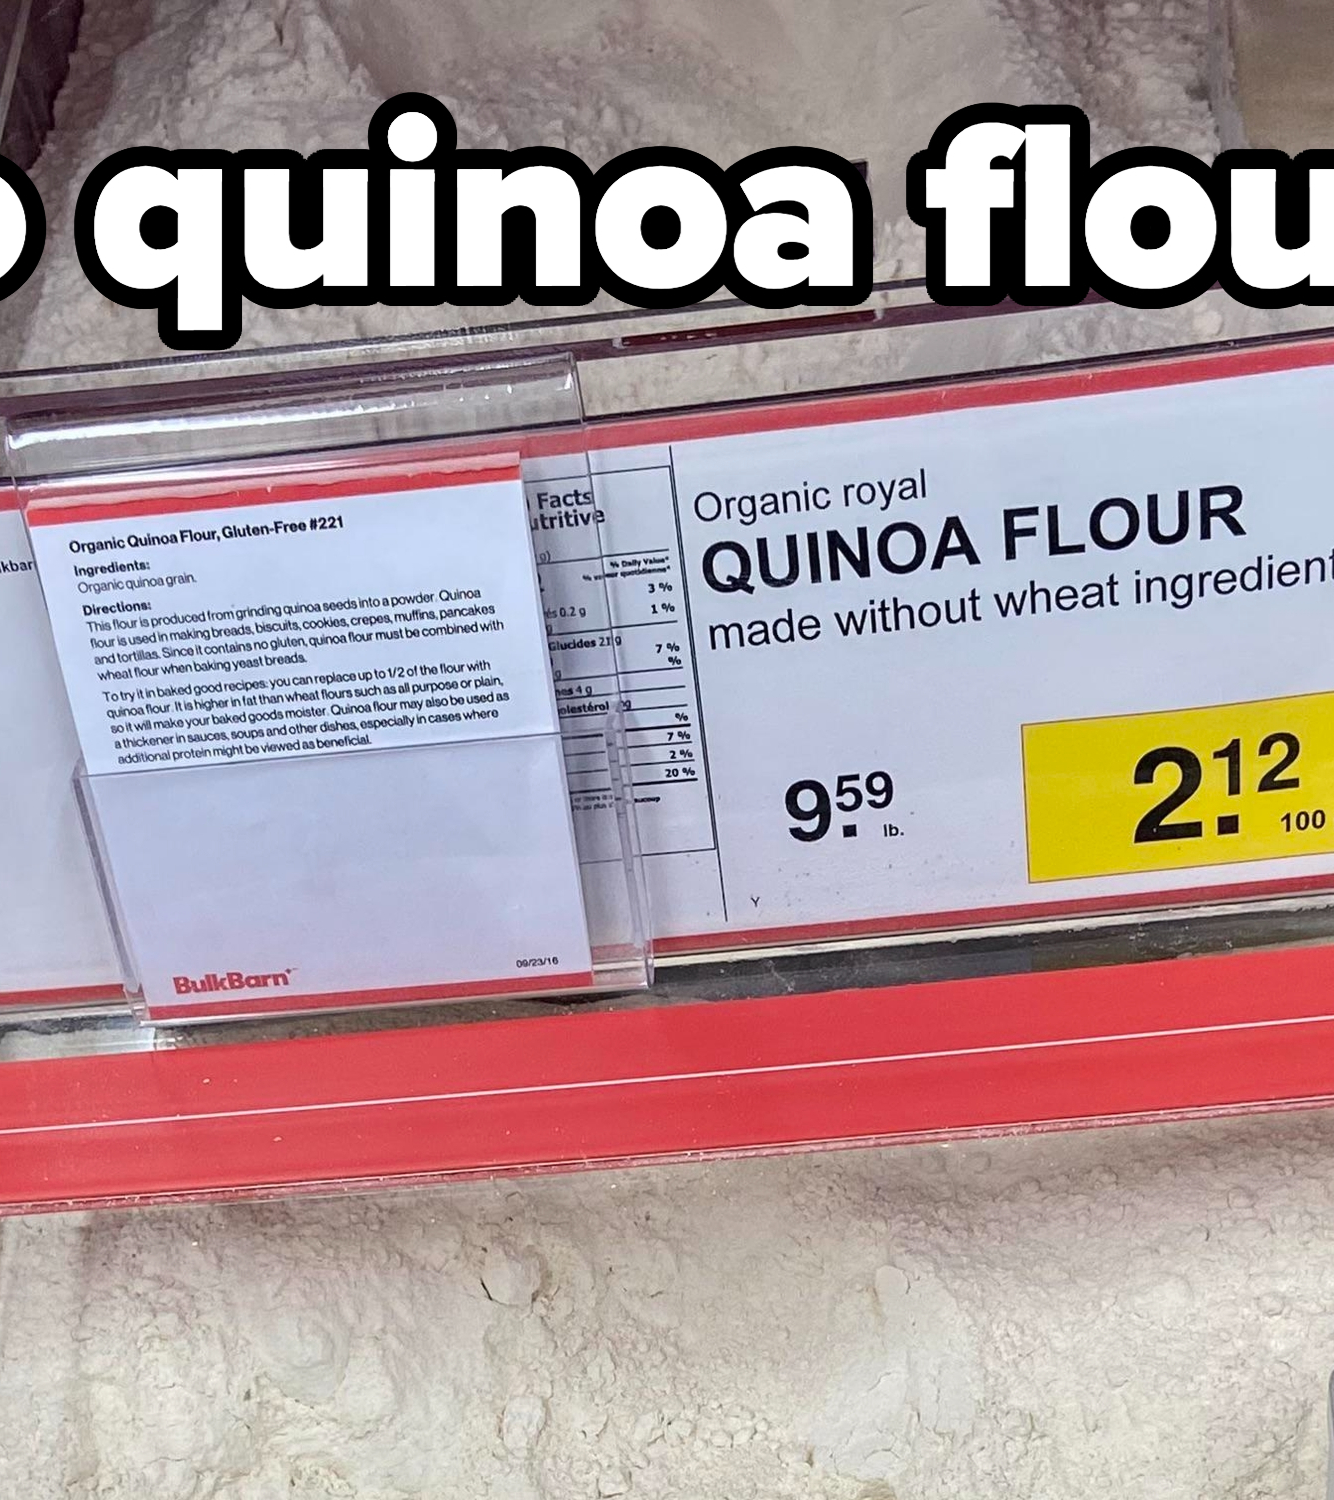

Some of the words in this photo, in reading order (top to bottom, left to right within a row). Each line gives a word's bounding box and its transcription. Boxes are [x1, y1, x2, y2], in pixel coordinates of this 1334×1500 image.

[537, 489, 594, 510] Facts
[695, 482, 830, 525] Organic
[844, 469, 925, 510] royal
[530, 509, 605, 531] utritive
[68, 536, 125, 554] Organic
[126, 532, 178, 547] Quinoa
[178, 528, 220, 543] Flour,
[221, 520, 307, 538] Gluten-Free
[309, 514, 343, 530] #221
[700, 512, 980, 595] QUINOA
[1004, 486, 1246, 560] FLOUR
[73, 559, 150, 577] Ingredients:
[77, 578, 124, 594] Organic
[124, 575, 165, 591] quinoa
[165, 571, 197, 587] grain.
[81, 600, 151, 616] Directions:
[85, 620, 112, 632] This
[111, 618, 137, 630] flour
[138, 616, 149, 627] is
[150, 610, 206, 628] produced
[206, 609, 235, 621] from
[235, 604, 282, 621] grinding
[282, 601, 322, 616] quinoa
[322, 597, 358, 611] seeds
[357, 596, 380, 608] into
[438, 588, 481, 601] Quinoa
[710, 609, 820, 649] made
[834, 588, 981, 636] without
[994, 575, 1119, 617] wheat
[89, 637, 115, 649] flour
[116, 635, 127, 646] is
[127, 631, 157, 645] used
[156, 630, 168, 642] in
[168, 627, 211, 641] making
[210, 623, 254, 638] breads,
[254, 619, 302, 633] biscuits,
[301, 616, 349, 630] cookies,
[349, 614, 393, 626] crepes,
[393, 608, 438, 622] muffins,
[438, 603, 495, 621] pancakes
[557, 701, 609, 715] olestérol
[1134, 733, 1306, 843] 2.12
[884, 824, 903, 836] lb.
[1281, 810, 1325, 832] 100
